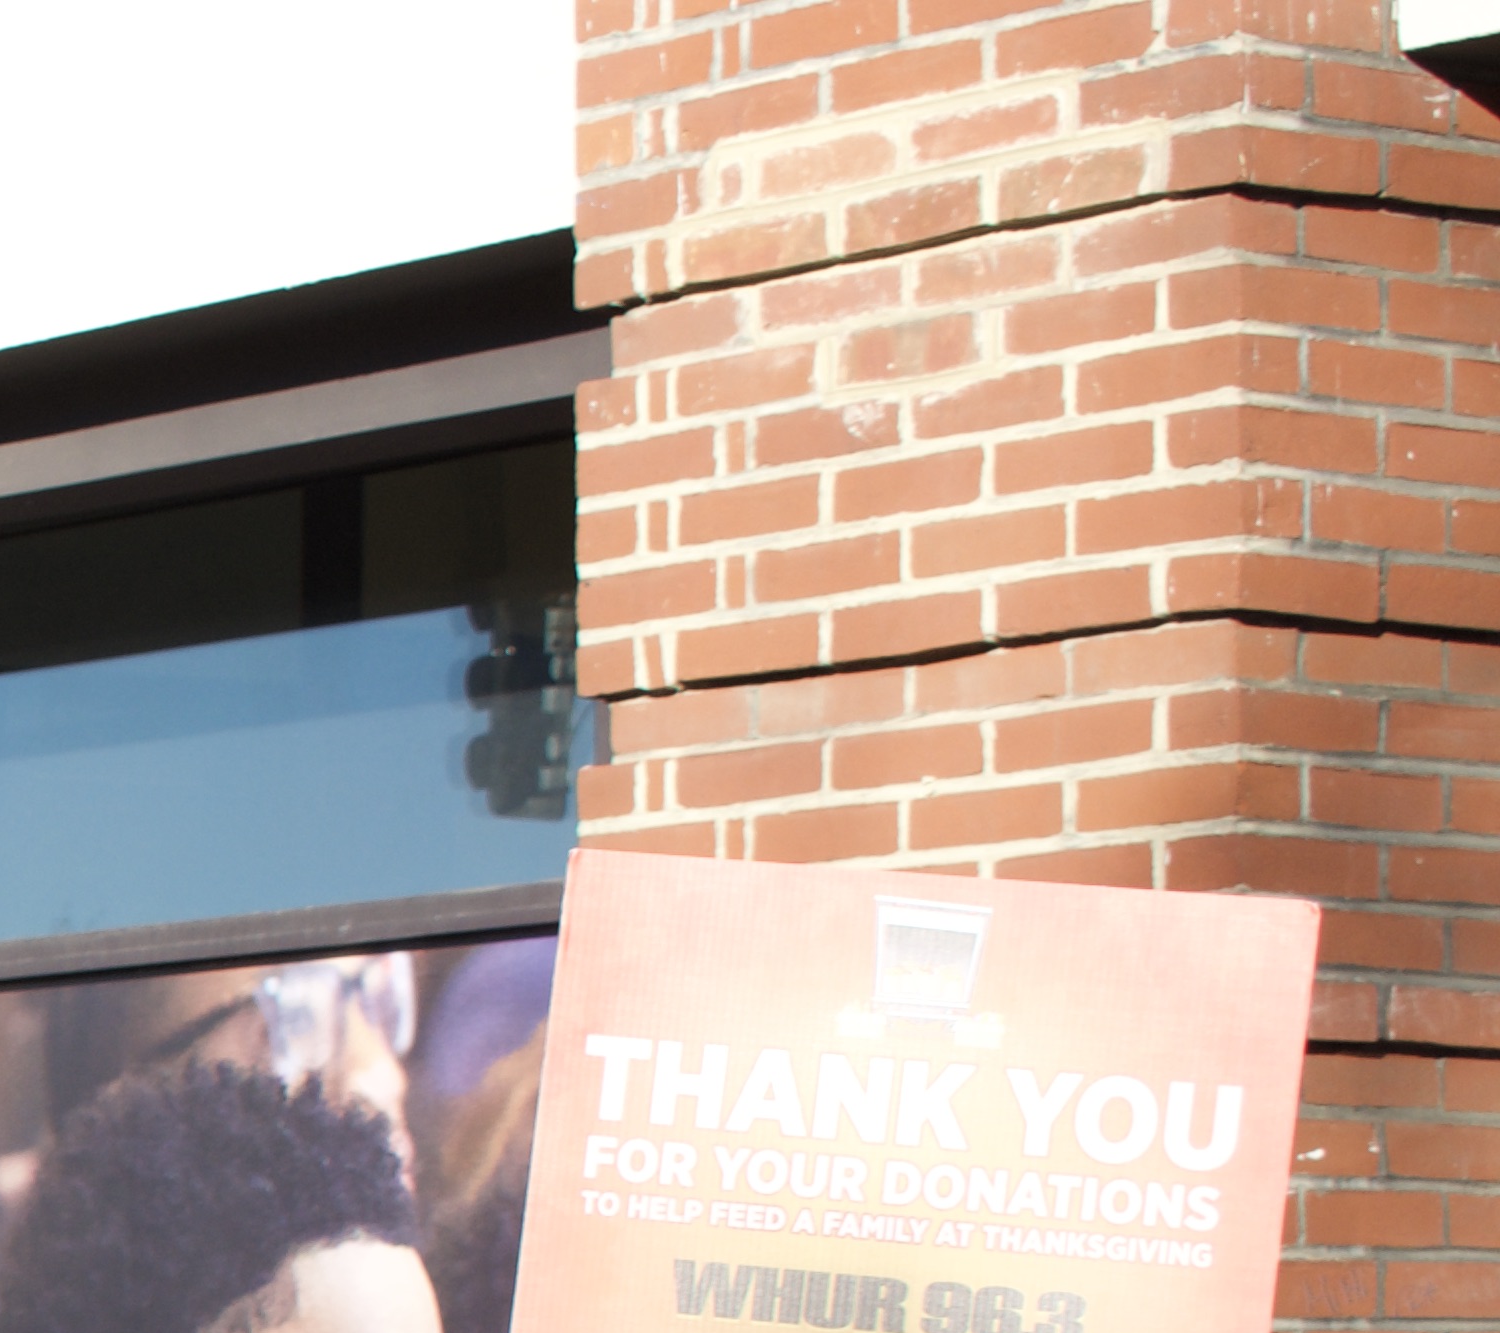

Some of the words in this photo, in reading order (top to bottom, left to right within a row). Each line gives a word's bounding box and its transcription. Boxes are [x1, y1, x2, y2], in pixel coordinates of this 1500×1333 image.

[583, 1031, 976, 1151] THANK
[1006, 1065, 1247, 1172] YOU
[581, 1133, 698, 1188] FOR
[712, 1143, 869, 1203] YOUR
[880, 1158, 1220, 1233] DONATIONS
